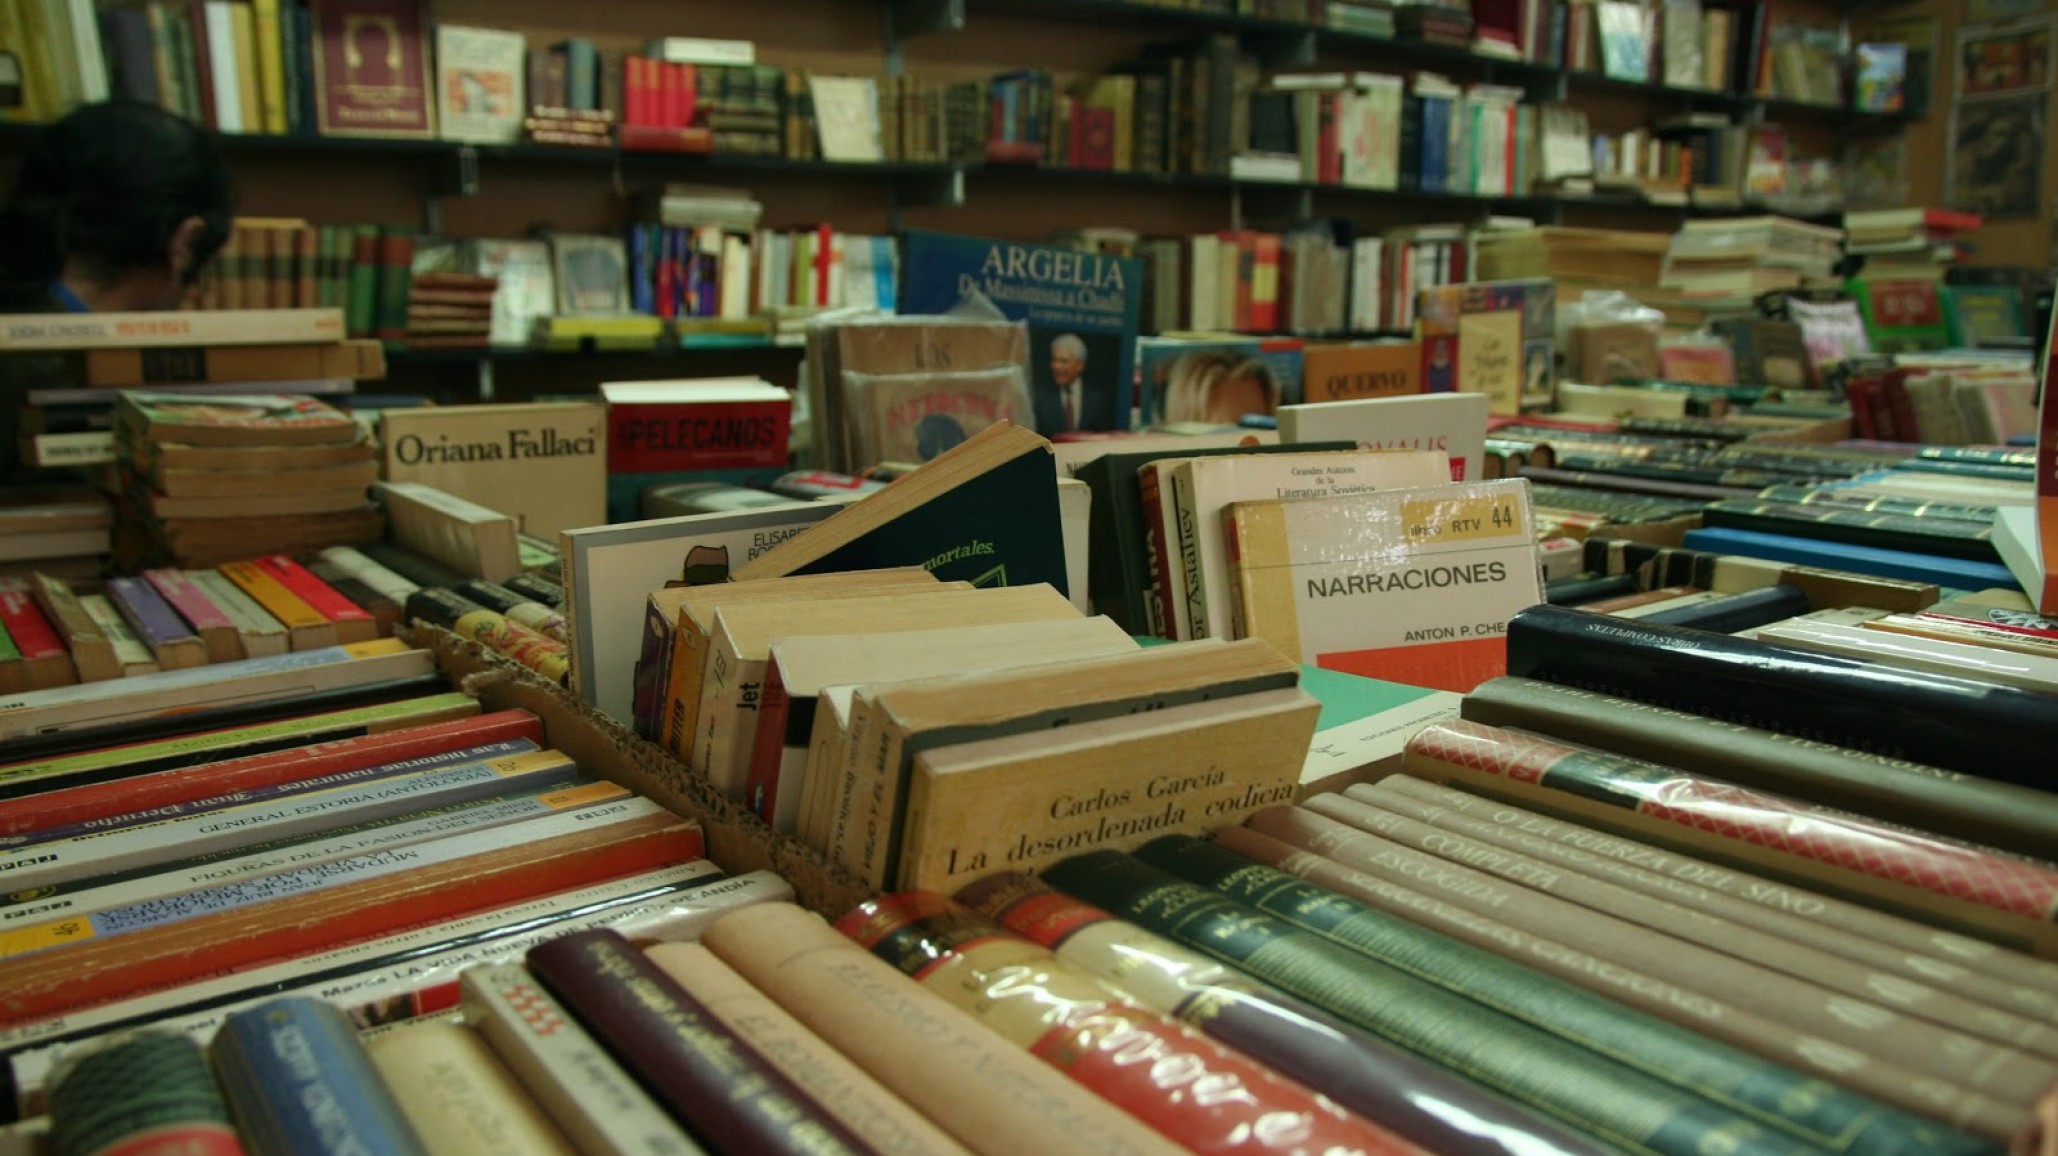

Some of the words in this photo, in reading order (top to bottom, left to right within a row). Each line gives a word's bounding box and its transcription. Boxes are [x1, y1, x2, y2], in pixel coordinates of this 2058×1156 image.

[982, 245, 1125, 290] ARGELIA
[628, 416, 776, 451] PELECANOS
[396, 433, 502, 467] Oriana
[508, 427, 597, 459] Fallaci
[1290, 467, 1323, 475] Grandes
[1325, 466, 1356, 475] Autores
[1315, 476, 1325, 485] de
[1328, 476, 1335, 485] la
[1276, 487, 1328, 499] Literatura
[1451, 518, 1481, 533] RTV
[1491, 505, 1514, 529] 44
[1306, 560, 1507, 599] NARRACIONES
[1404, 625, 1455, 643] ANTON
[1459, 624, 1474, 638] P.
[1474, 621, 1507, 636] CHE
[1584, 622, 1660, 646] COMPLETAS
[735, 681, 761, 712] Jet
[1769, 733, 1828, 753] GALA
[379, 750, 469, 775] historias
[1829, 746, 1963, 783] ANTONIO
[277, 767, 375, 793] naturales
[1050, 787, 1131, 821] Carlos
[1146, 765, 1225, 799] García
[192, 790, 253, 810] Juan
[83, 804, 189, 830] Perucho
[198, 808, 291, 835] GENERAL
[294, 793, 374, 815] ESTORIA
[428, 808, 488, 827] GABRIEL
[947, 847, 988, 877] La
[1006, 801, 1186, 865] desordenada
[1205, 778, 1293, 818] codicia
[190, 857, 285, 884] FIGURAS
[289, 848, 322, 862] DE
[332, 842, 361, 853] LA
[433, 820, 475, 833] DEL
[323, 849, 419, 877] MUDARSE
[1420, 832, 1558, 889] COMPLETA
[1522, 814, 1552, 838] LA
[1558, 827, 1665, 873] FUERZA
[1677, 860, 1732, 890] DEL
[1740, 880, 1826, 916] SINO
[266, 856, 359, 885] VERDAD
[242, 888, 275, 901] RUIZ
[255, 876, 302, 892] POR
[289, 879, 323, 891] JUAN
[575, 883, 629, 899] Castro
[206, 899, 226, 909] DE
[505, 902, 557, 919] Teresa
[393, 966, 422, 980] LA
[428, 951, 476, 971] VIDA
[699, 876, 758, 900] ANDÍA
